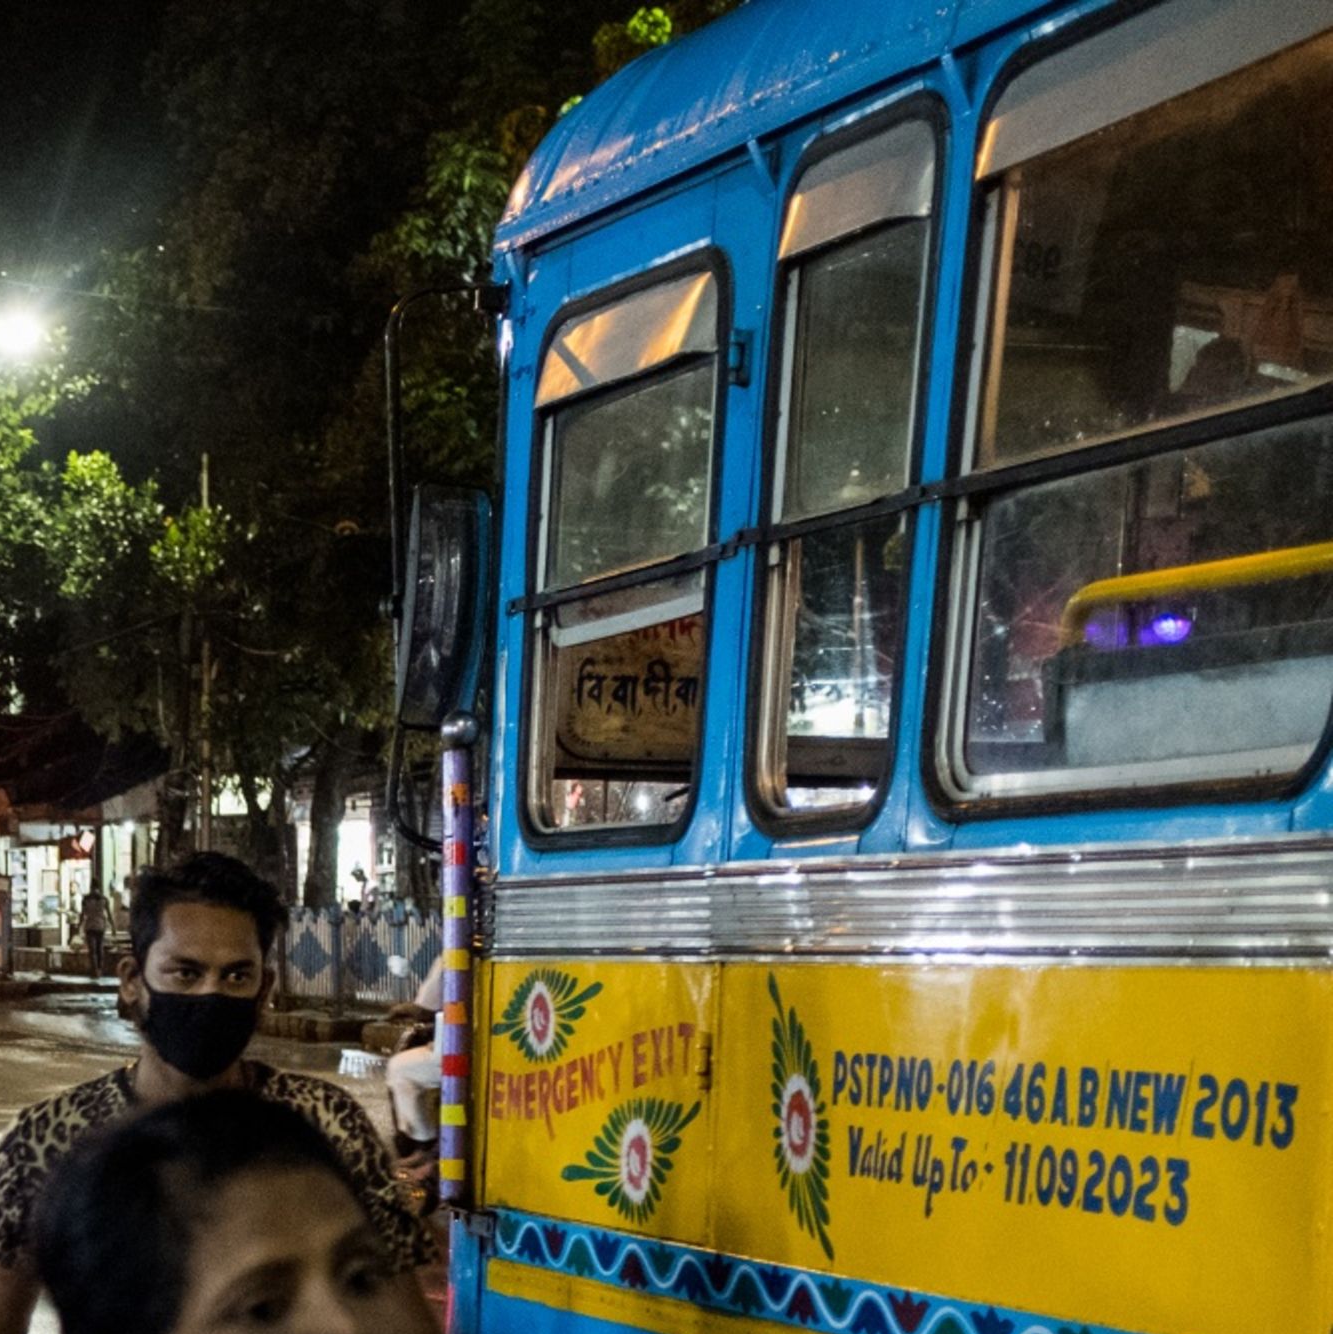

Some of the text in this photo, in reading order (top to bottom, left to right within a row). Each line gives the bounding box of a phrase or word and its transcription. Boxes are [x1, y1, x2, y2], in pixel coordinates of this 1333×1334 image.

[491, 1022, 696, 1141] EMERGENCY EXIT
[848, 1125, 907, 1184] Valid
